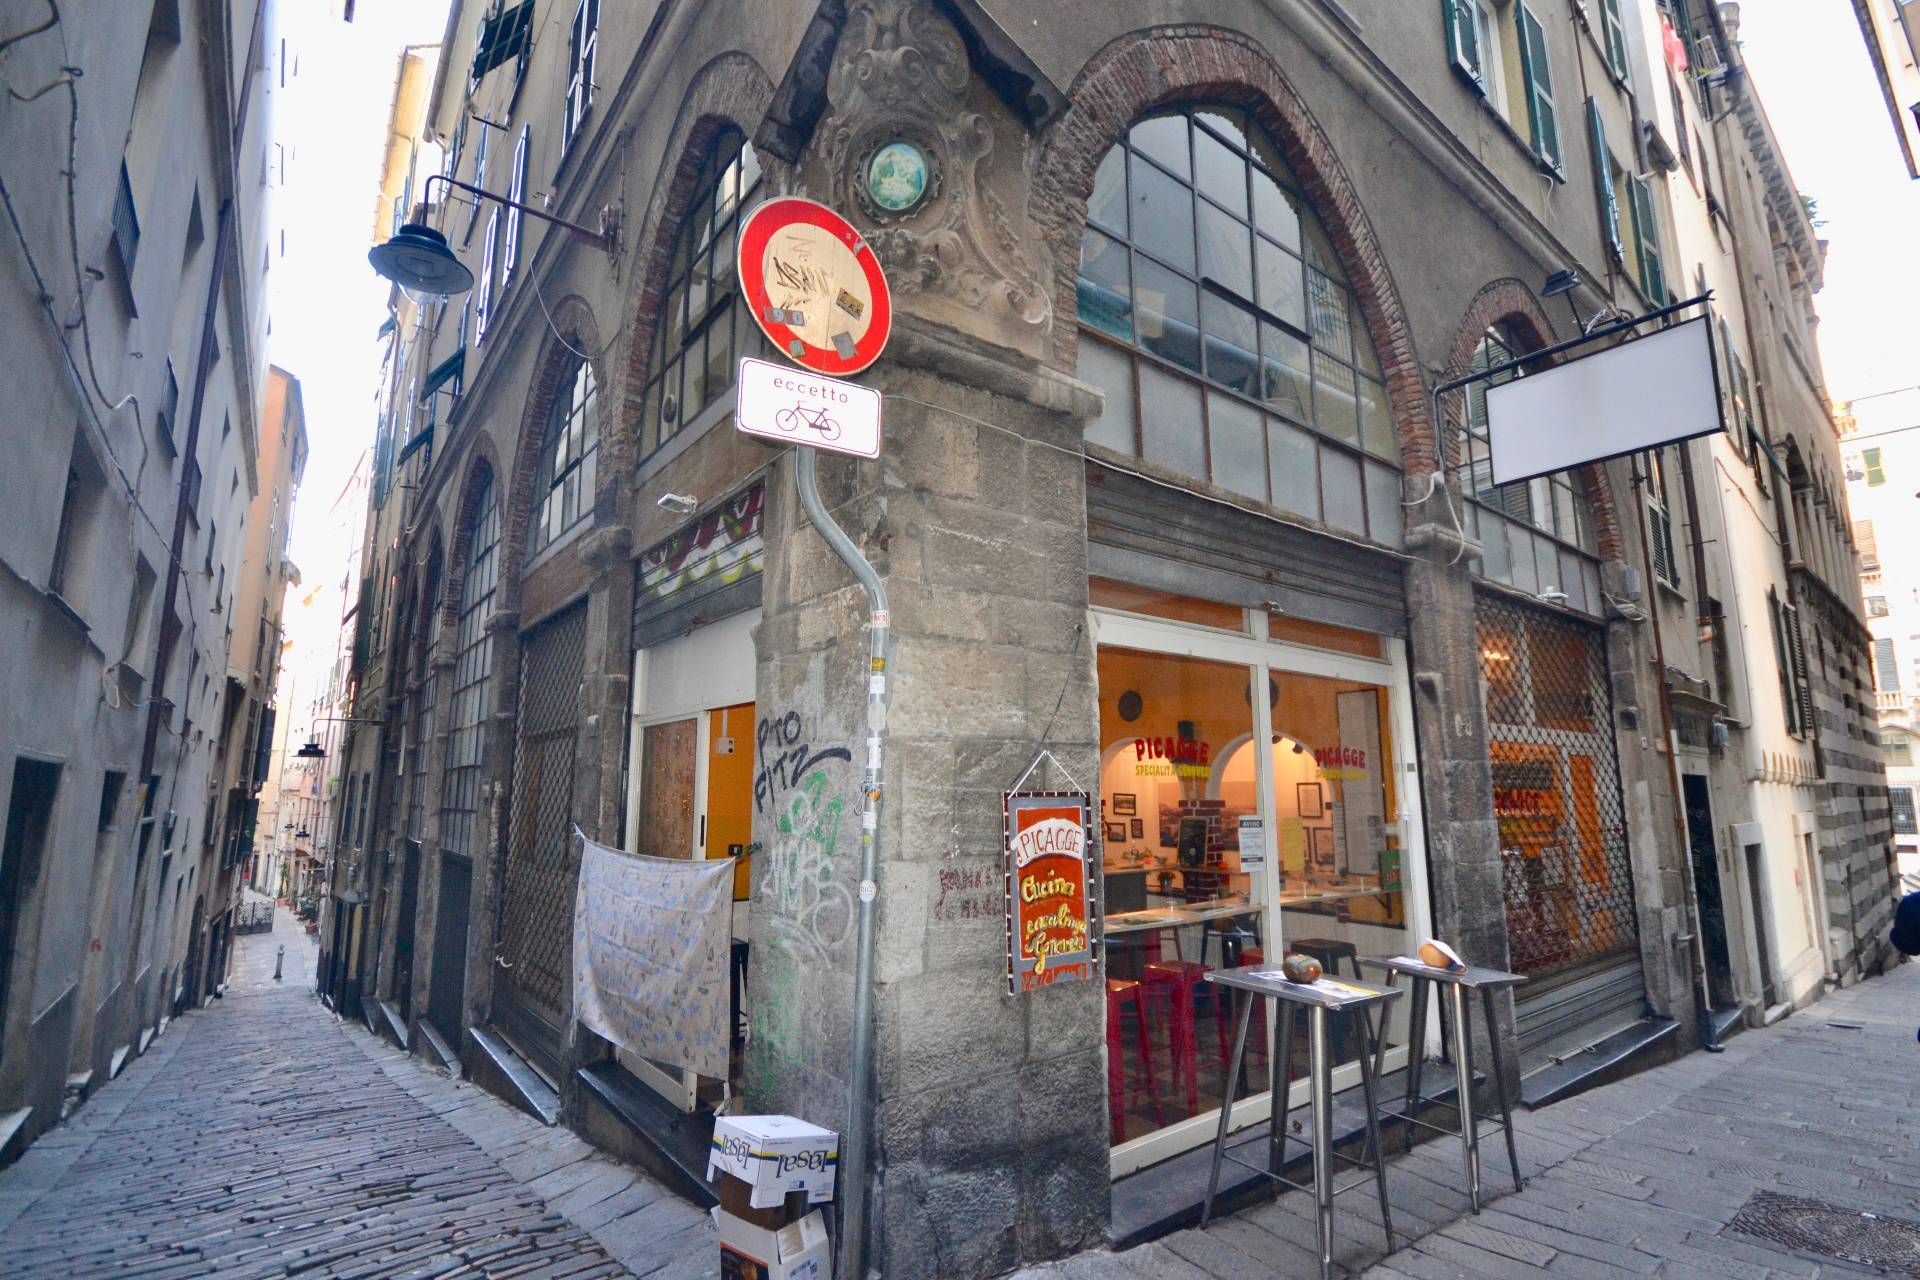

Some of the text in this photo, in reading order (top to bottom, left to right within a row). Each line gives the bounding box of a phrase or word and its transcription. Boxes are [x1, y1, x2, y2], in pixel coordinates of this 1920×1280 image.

[773, 376, 849, 404] eccetto
[1134, 736, 1210, 764] PICAGGE
[1018, 827, 1083, 857] PICAGGE
[1021, 869, 1075, 904] Cucina
